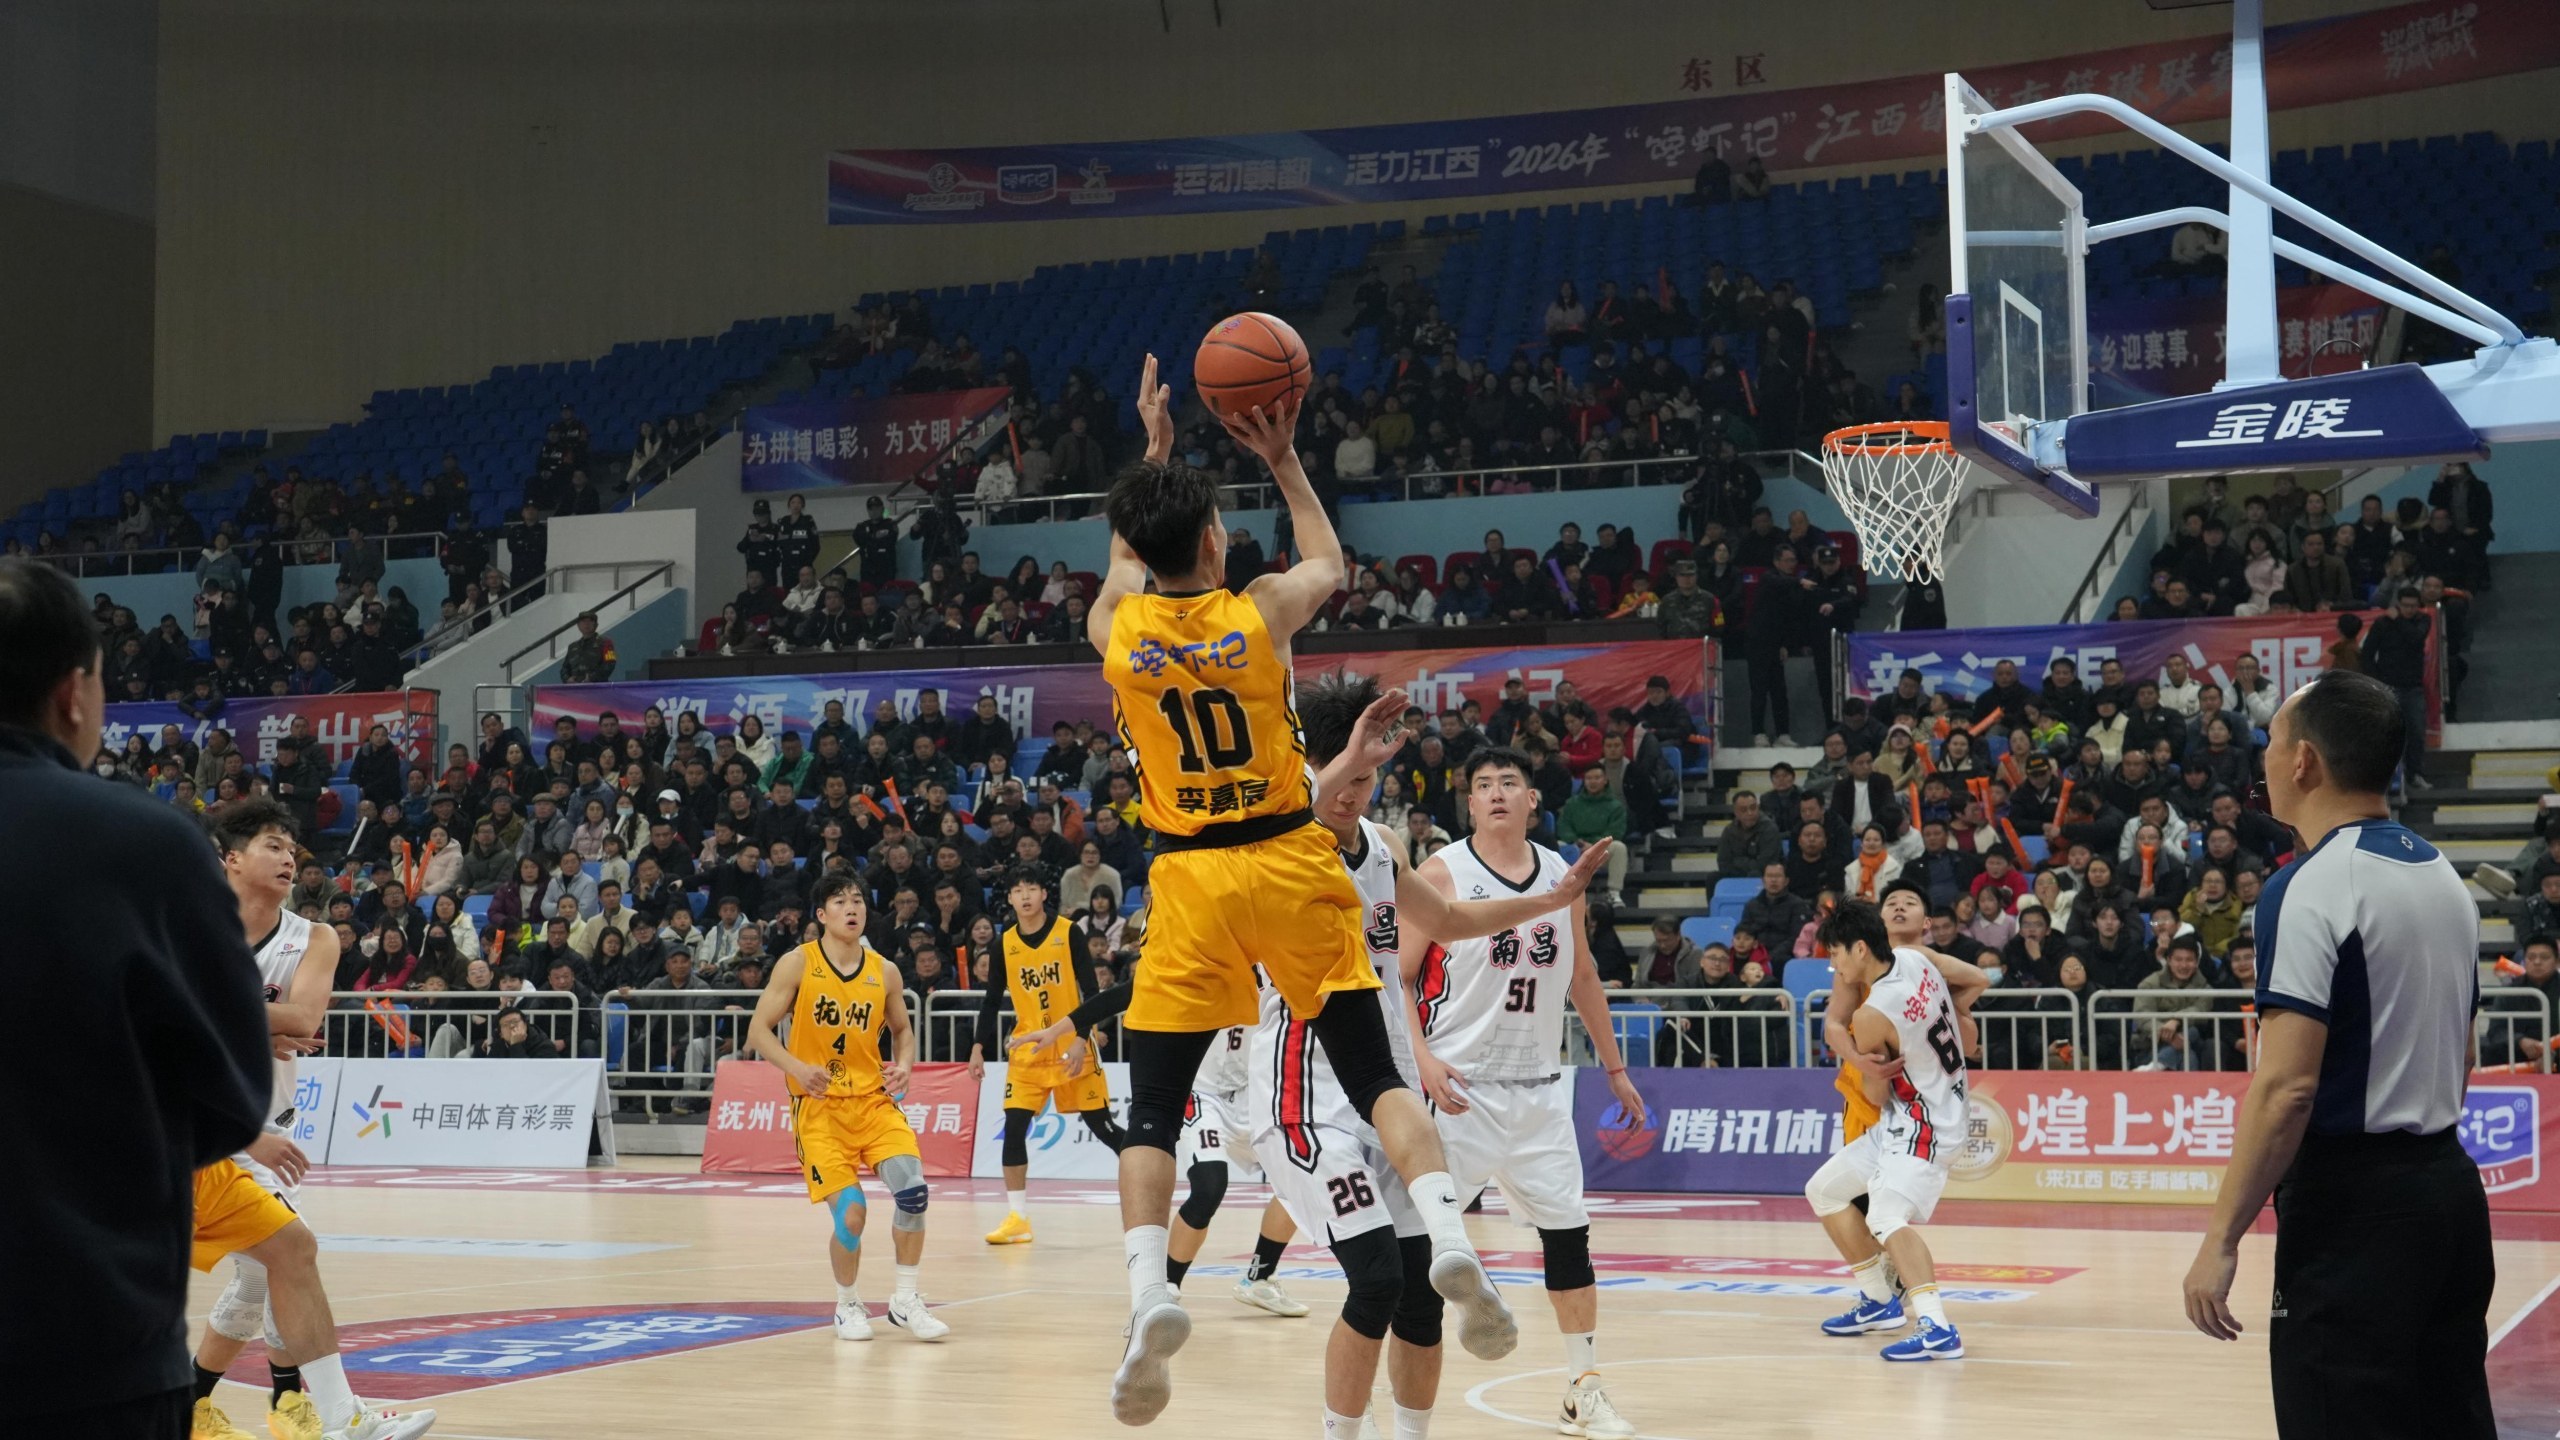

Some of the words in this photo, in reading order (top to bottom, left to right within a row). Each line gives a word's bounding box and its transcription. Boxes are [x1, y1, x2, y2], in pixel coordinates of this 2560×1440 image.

[1680, 53, 1766, 91] 东区
[2204, 398, 2357, 443] 金陵
[1129, 630, 1248, 677] 馋虾记
[1159, 686, 1255, 774] 10
[1489, 922, 1559, 969] 南昌
[1021, 962, 1061, 991] 抚州
[813, 994, 873, 1032] 抚州
[1504, 977, 1537, 1014] 51
[832, 1033, 847, 1055] 4
[1226, 1027, 1244, 1052] 16
[411, 1101, 576, 1131] 中国体育彩票
[717, 1099, 962, 1135] 抚州市育局
[2017, 1087, 2236, 1156] 煌上煌
[1198, 1129, 1220, 1149] 16
[811, 1165, 823, 1186] 4
[1327, 1170, 1375, 1217] 26
